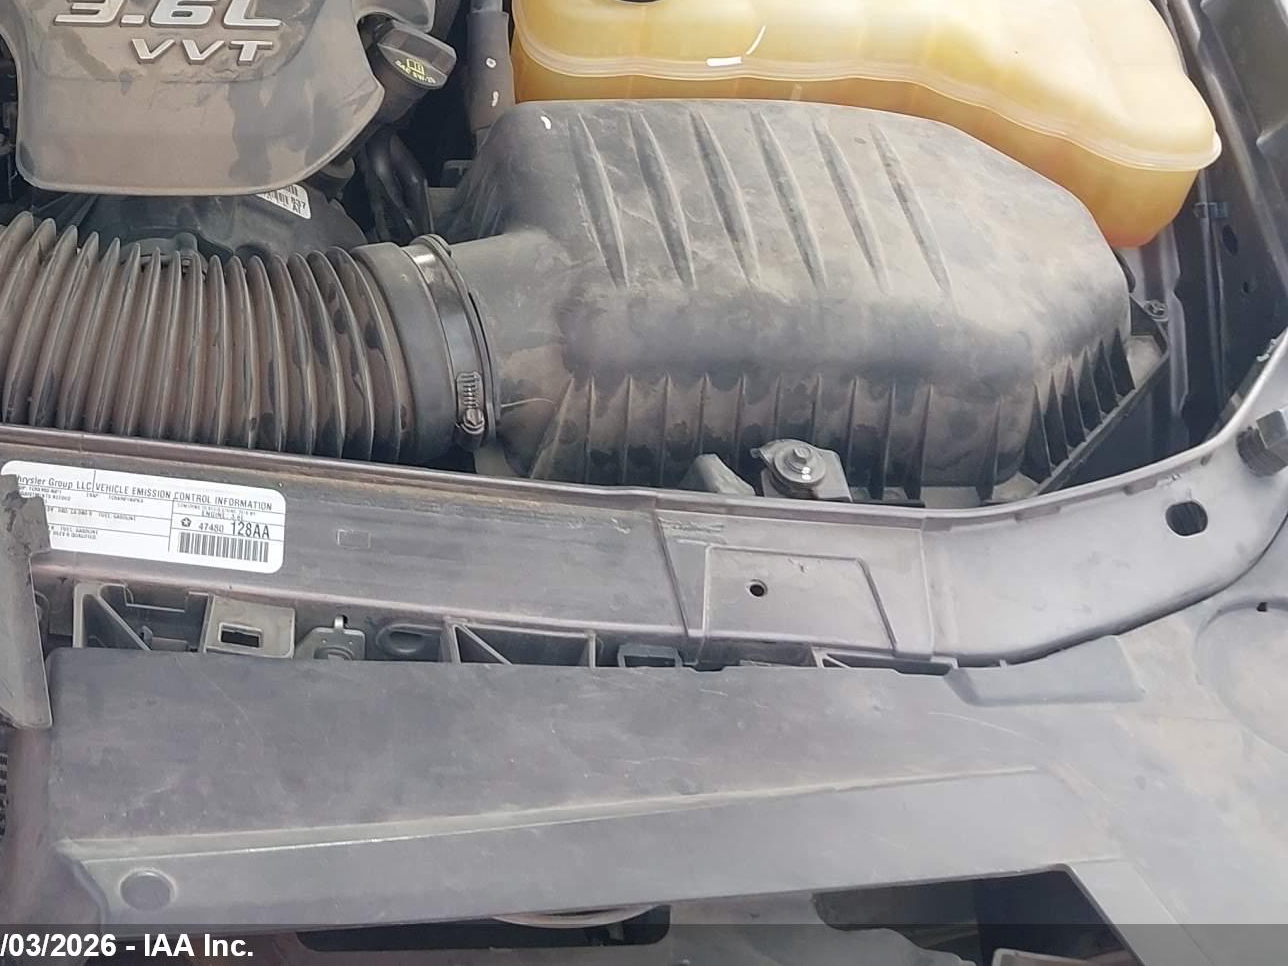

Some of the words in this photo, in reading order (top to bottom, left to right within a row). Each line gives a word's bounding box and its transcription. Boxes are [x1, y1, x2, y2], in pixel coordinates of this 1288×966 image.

[130, 38, 274, 66] VVT
[17, 474, 46, 486] hrysler
[48, 478, 73, 490] Group
[76, 481, 92, 490] LLC
[96, 482, 130, 495] VEHICLE
[132, 486, 172, 499] EMISSION
[173, 491, 210, 504] CONTROL
[214, 496, 273, 511] INFORMATION
[198, 522, 224, 533] 47480
[231, 521, 270, 539] 128AA
